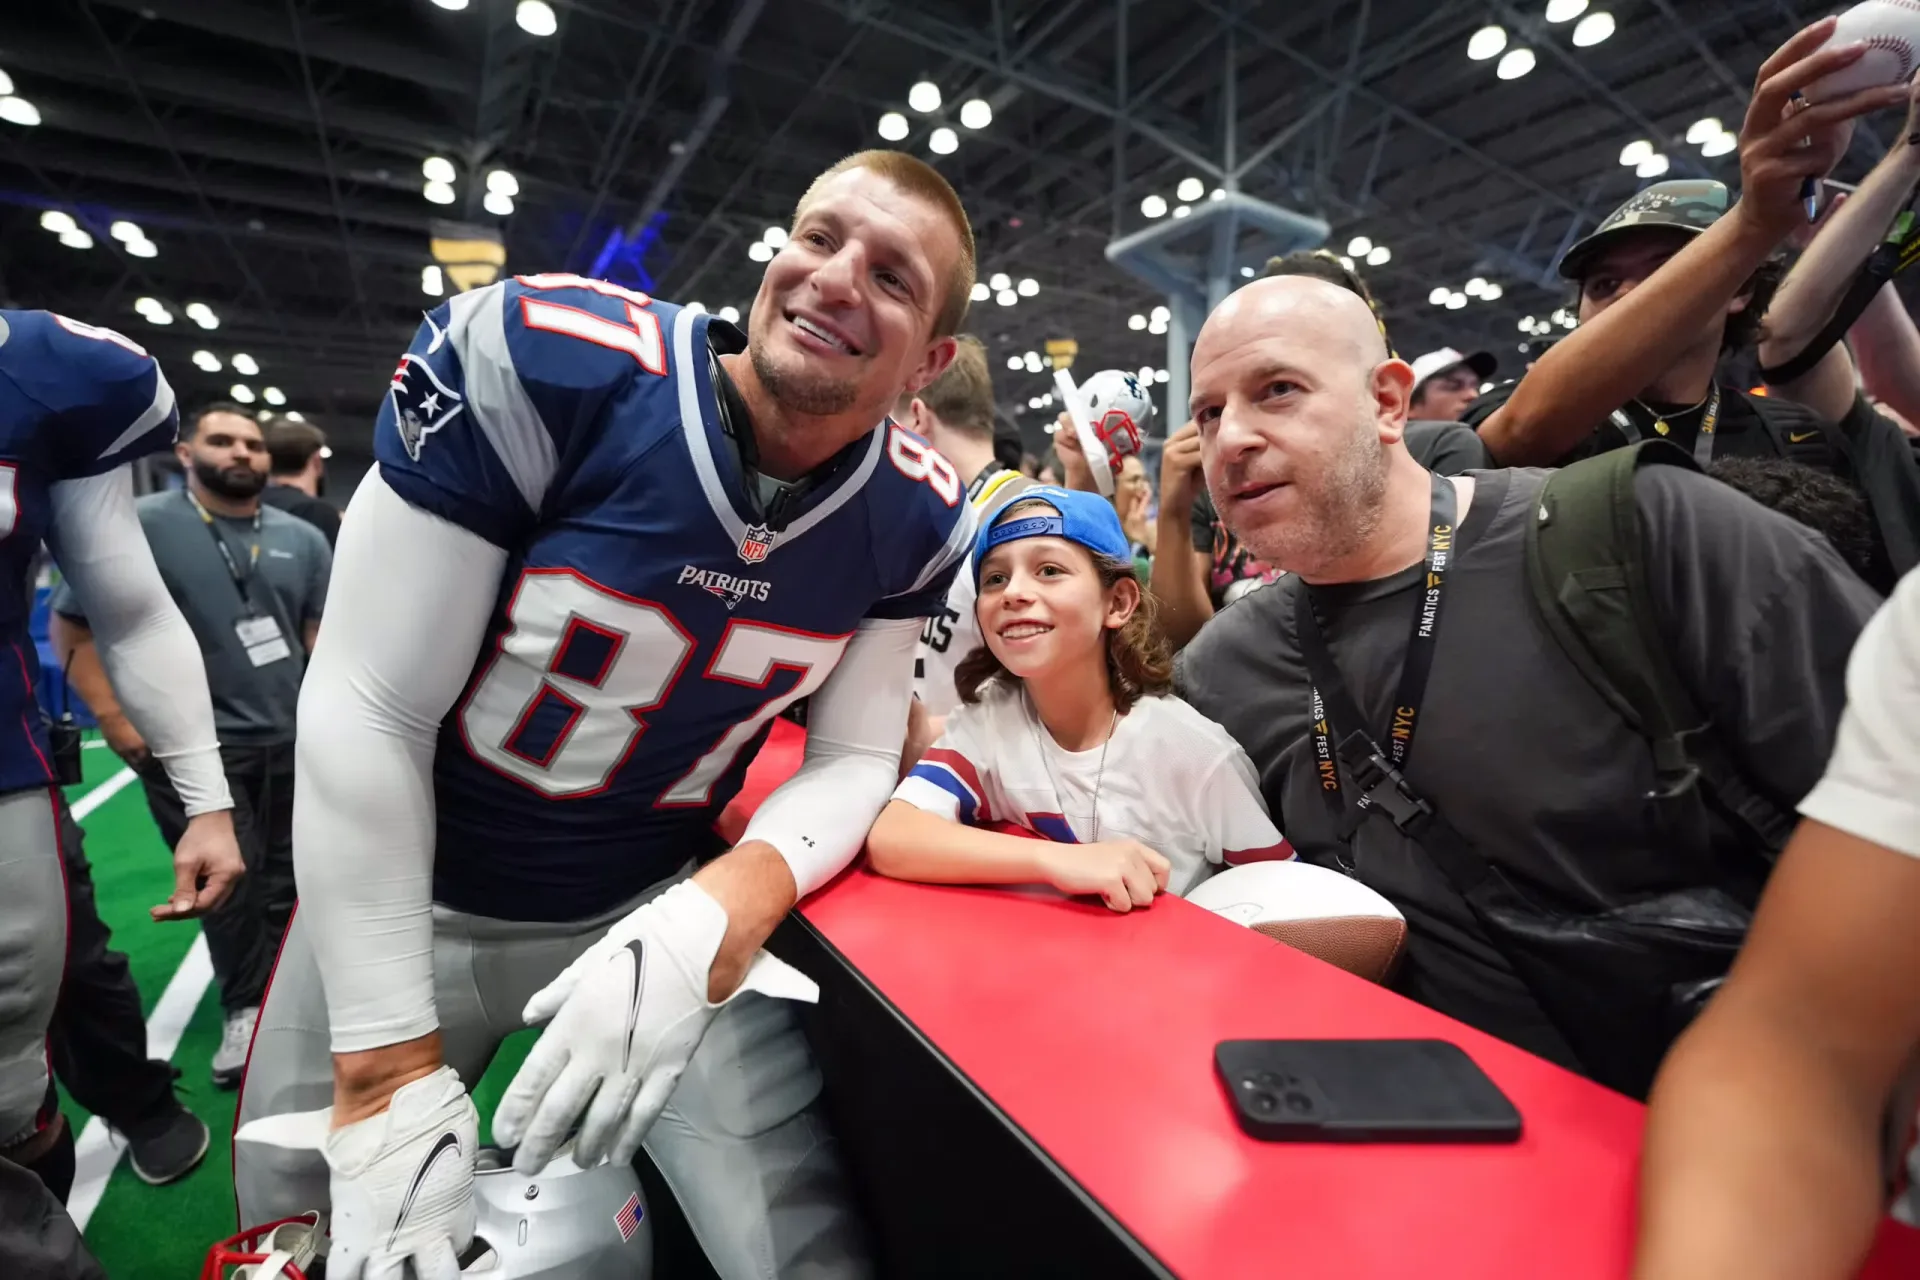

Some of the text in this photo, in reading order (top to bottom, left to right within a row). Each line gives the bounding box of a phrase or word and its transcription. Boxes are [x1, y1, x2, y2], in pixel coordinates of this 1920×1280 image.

[1702, 415, 1716, 433] NYC
[742, 540, 766, 559] NFL
[676, 564, 772, 602] PATRIOTS
[1418, 525, 1452, 637] FANATICS FEST NYC
[456, 566, 856, 808] 87
[1315, 735, 1330, 759] FEST
[1391, 706, 1415, 763] FEST NYC
[1318, 760, 1338, 790] NYC
